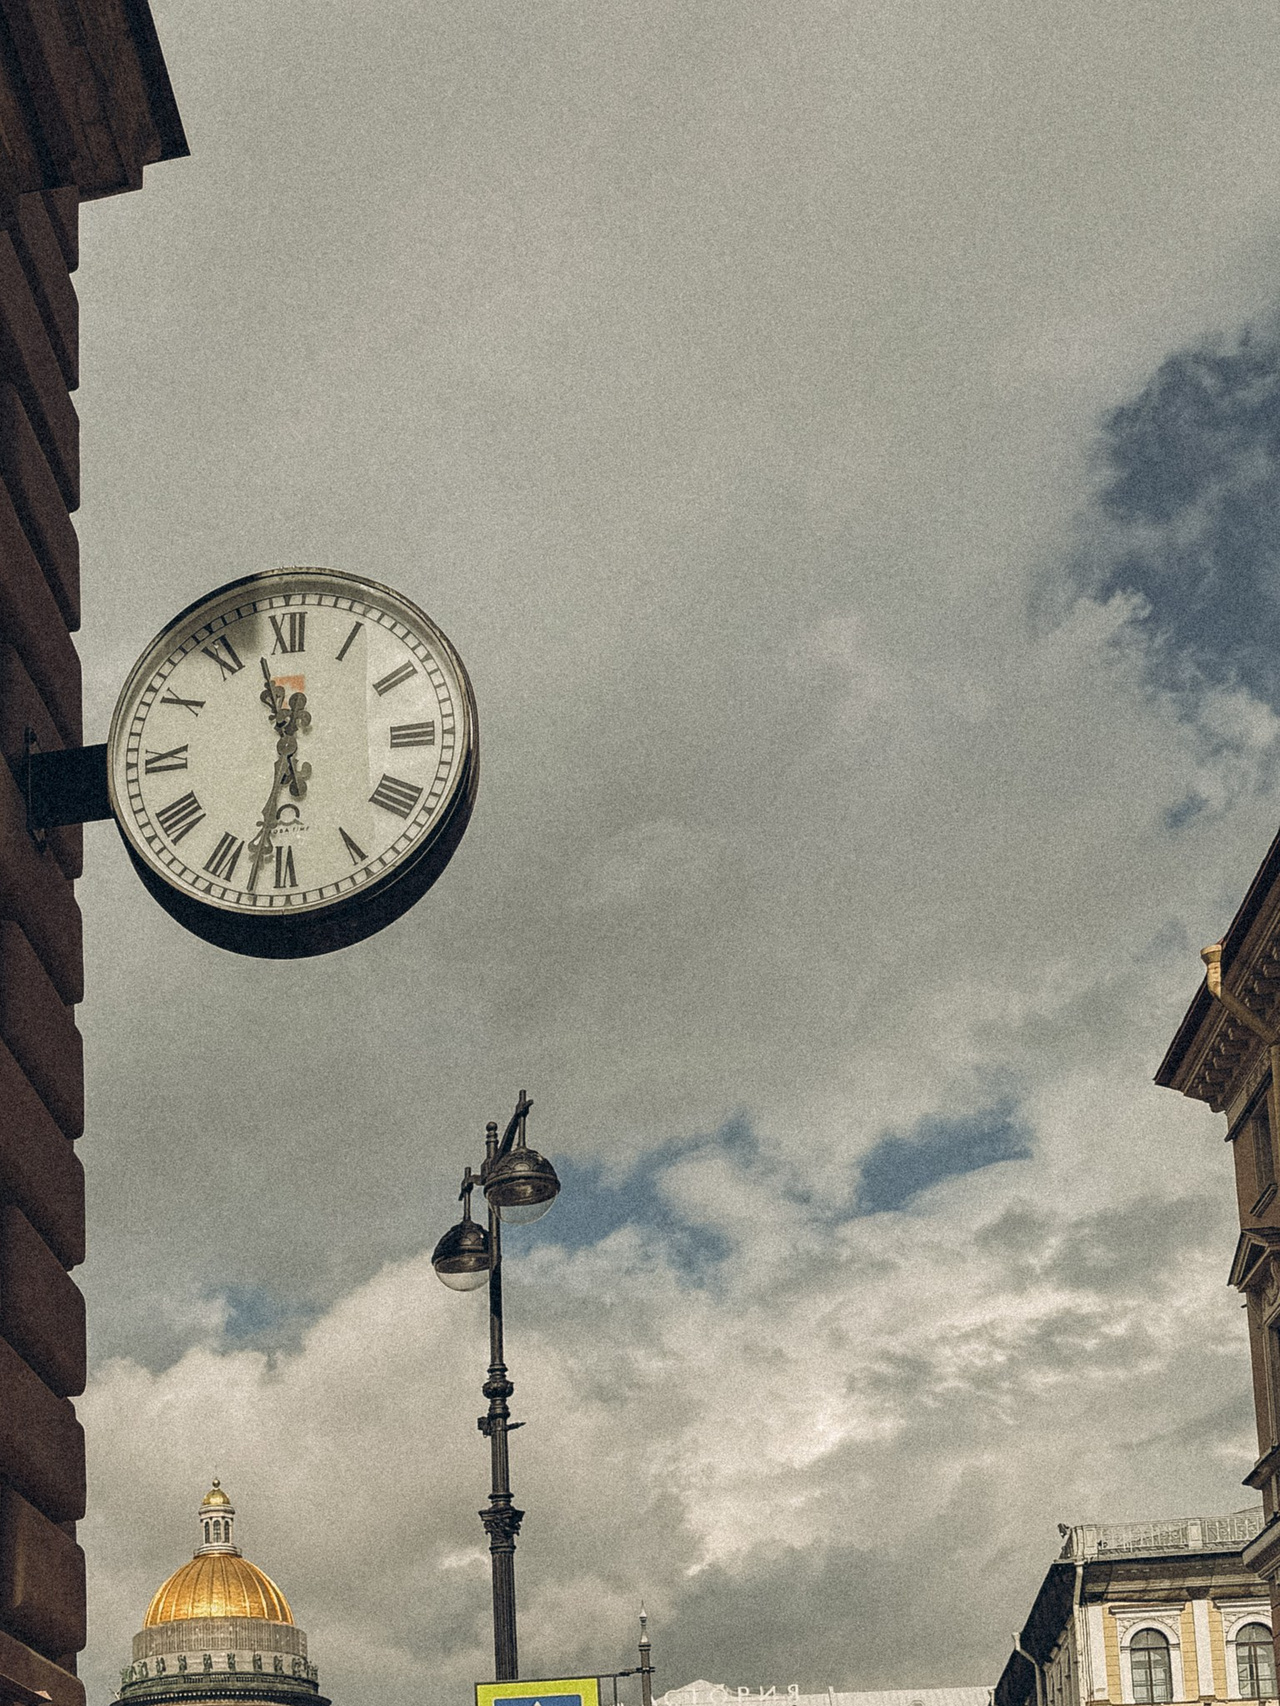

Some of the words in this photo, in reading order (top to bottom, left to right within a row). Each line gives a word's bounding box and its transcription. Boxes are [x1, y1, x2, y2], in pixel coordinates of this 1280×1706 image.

[269, 611, 308, 655] XII
[336, 621, 364, 661] I
[202, 633, 244, 682] XI
[373, 660, 418, 696] II
[160, 687, 206, 717] X
[390, 720, 435, 748] III
[145, 743, 189, 775] IX
[156, 790, 207, 846] VIII
[203, 831, 245, 883] VII
[338, 826, 369, 866] V
[274, 845, 299, 889] VI
